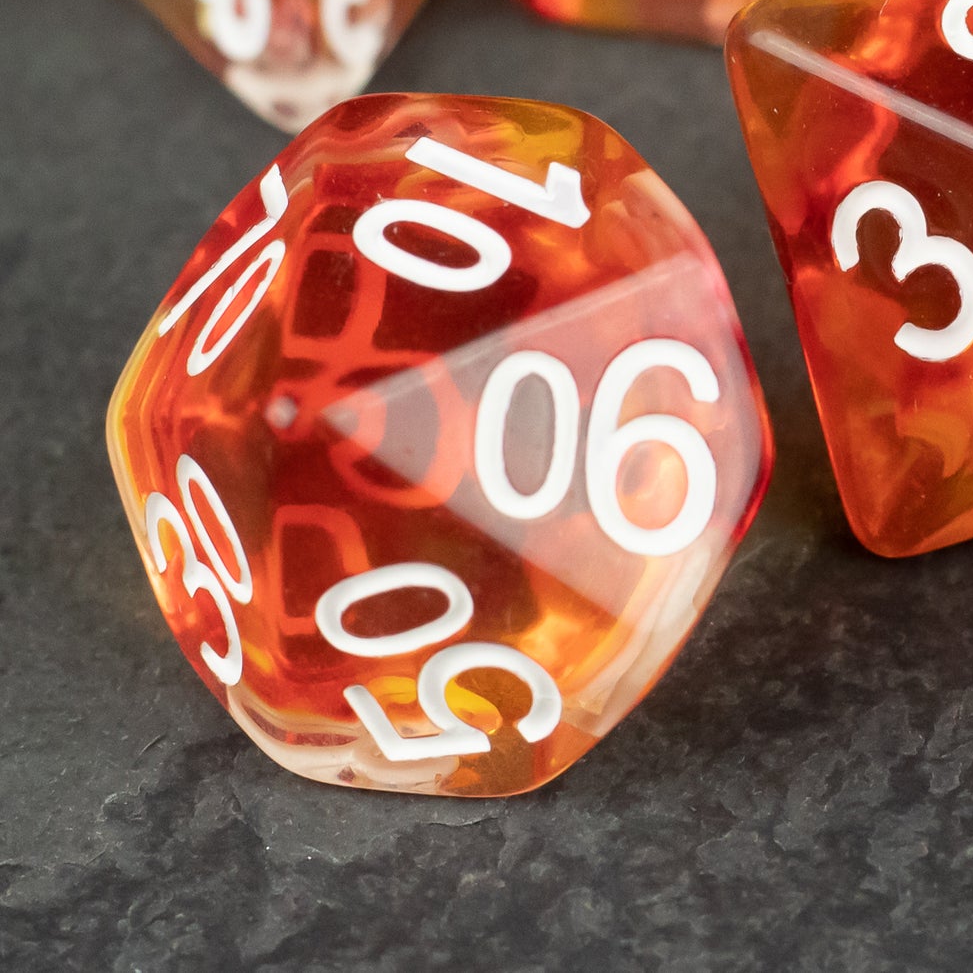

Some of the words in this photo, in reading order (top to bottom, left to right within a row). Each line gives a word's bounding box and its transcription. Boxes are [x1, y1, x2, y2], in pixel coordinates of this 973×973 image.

[352, 136, 591, 292] 10
[145, 454, 254, 685] 30
[315, 561, 562, 762] 50
